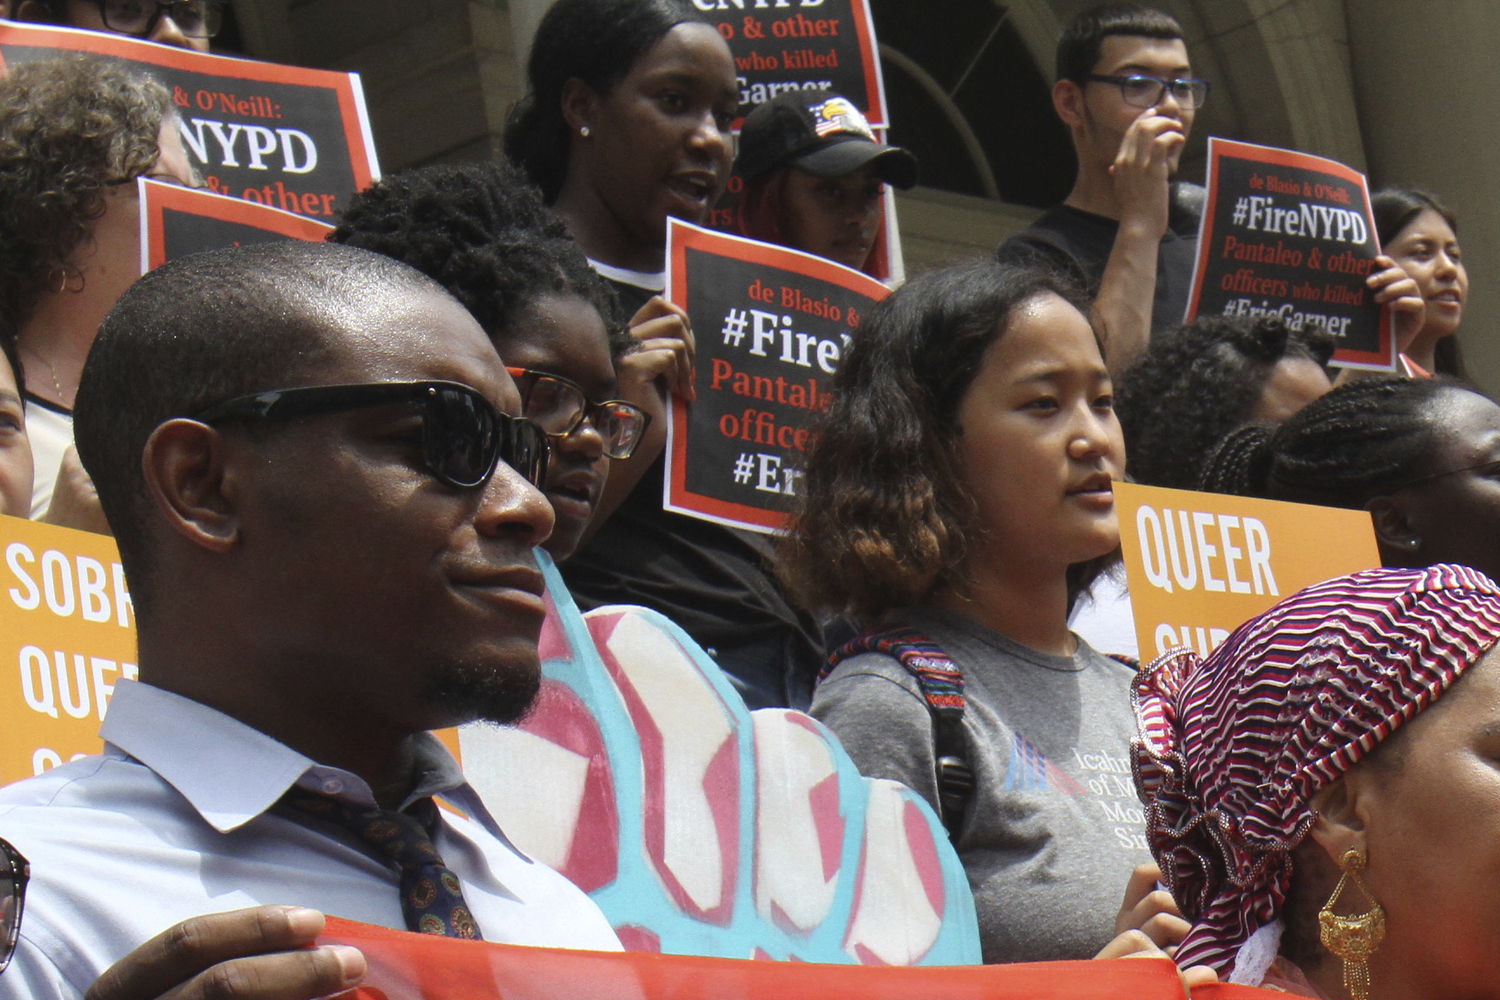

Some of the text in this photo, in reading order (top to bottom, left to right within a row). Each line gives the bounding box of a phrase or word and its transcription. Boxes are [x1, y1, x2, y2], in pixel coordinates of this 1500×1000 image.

[743, 16, 766, 39] &
[772, 13, 840, 38] other
[736, 49, 838, 70] who killed
[173, 85, 191, 107] &
[243, 181, 336, 215] other
[1266, 176, 1300, 196] Blasio
[1232, 195, 1368, 245] #FireNYPD
[1222, 235, 1376, 276] Pantaleo & other
[749, 279, 774, 303] de
[781, 286, 841, 322] Blasio
[1221, 269, 1364, 306] officers who killed
[721, 308, 853, 374] #Fire
[719, 408, 823, 452] office
[1136, 504, 1280, 597] QUEER
